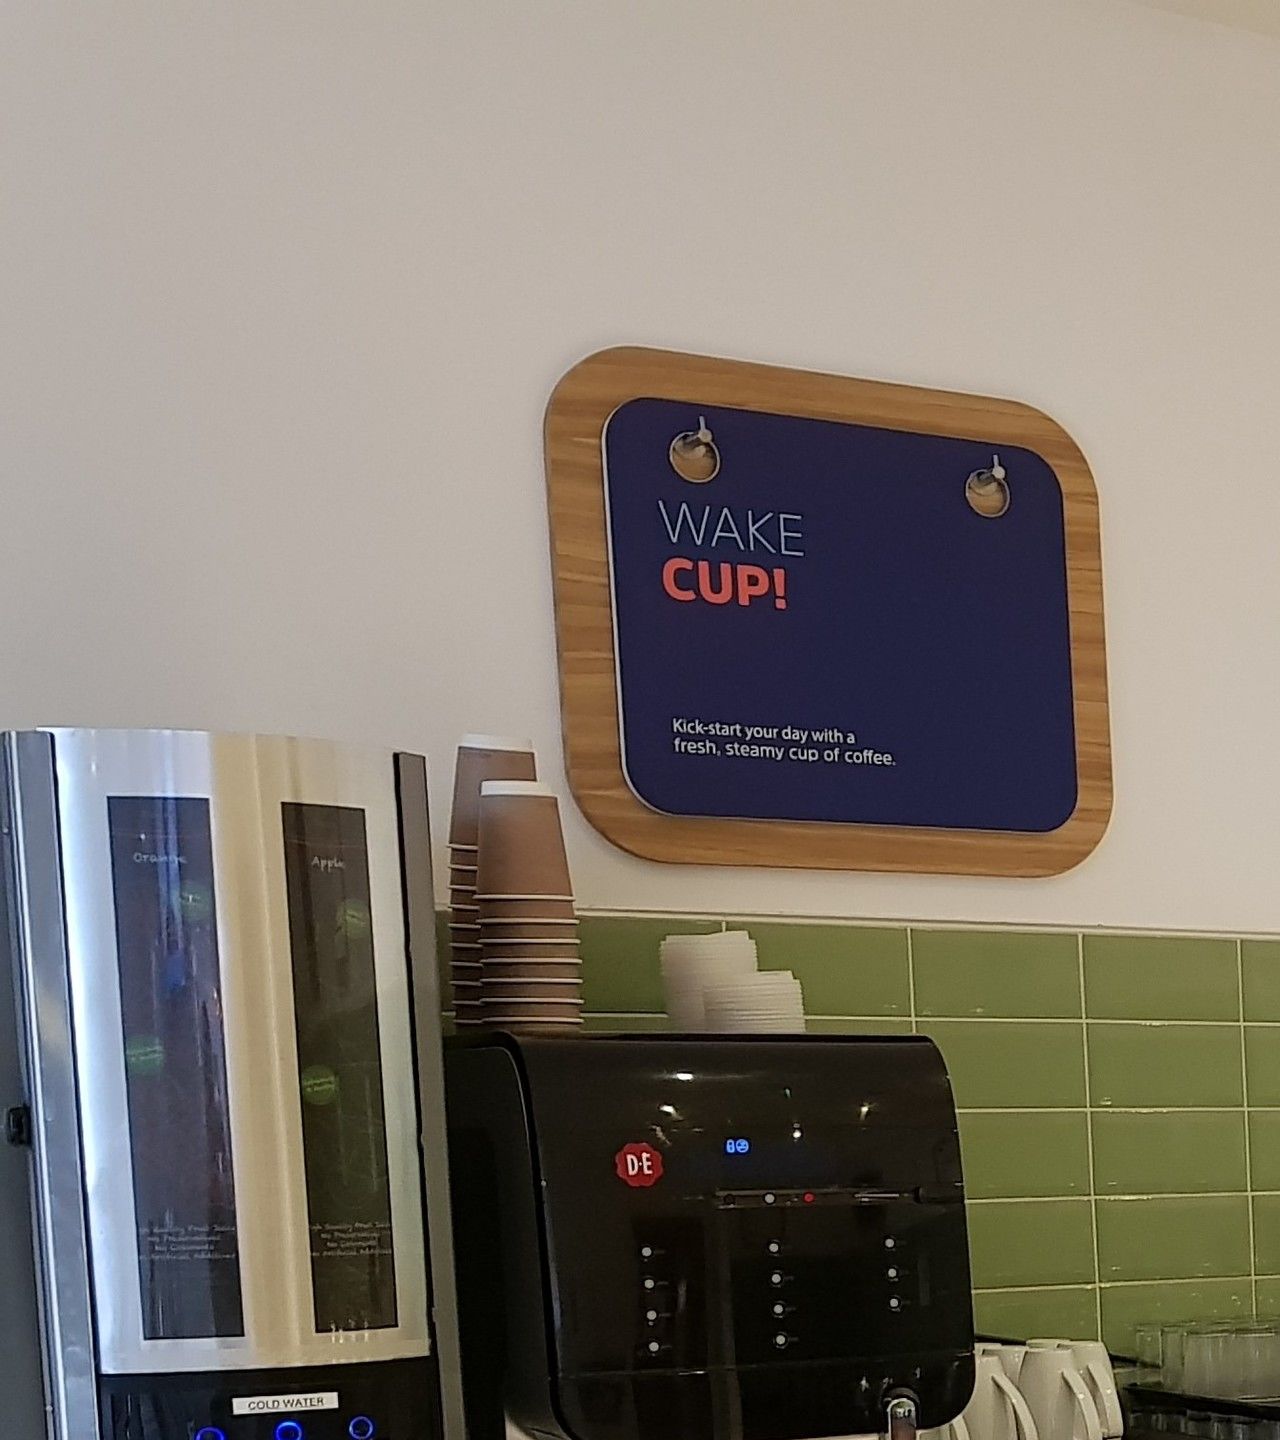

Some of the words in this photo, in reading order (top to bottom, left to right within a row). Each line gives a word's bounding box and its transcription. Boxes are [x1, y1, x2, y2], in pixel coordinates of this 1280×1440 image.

[658, 499, 805, 557] WAKE
[662, 557, 788, 610] CUP!
[672, 718, 742, 738] Kick-start
[745, 727, 779, 740] your
[781, 726, 808, 744] day
[811, 729, 843, 743] with
[847, 732, 855, 744] a
[674, 738, 721, 756] fresh,
[725, 742, 784, 761] steamy
[789, 749, 819, 763] cup
[824, 748, 840, 762] of
[845, 750, 897, 766] coffee.
[248, 1399, 280, 1411] COLD
[283, 1396, 324, 1408] WATER
